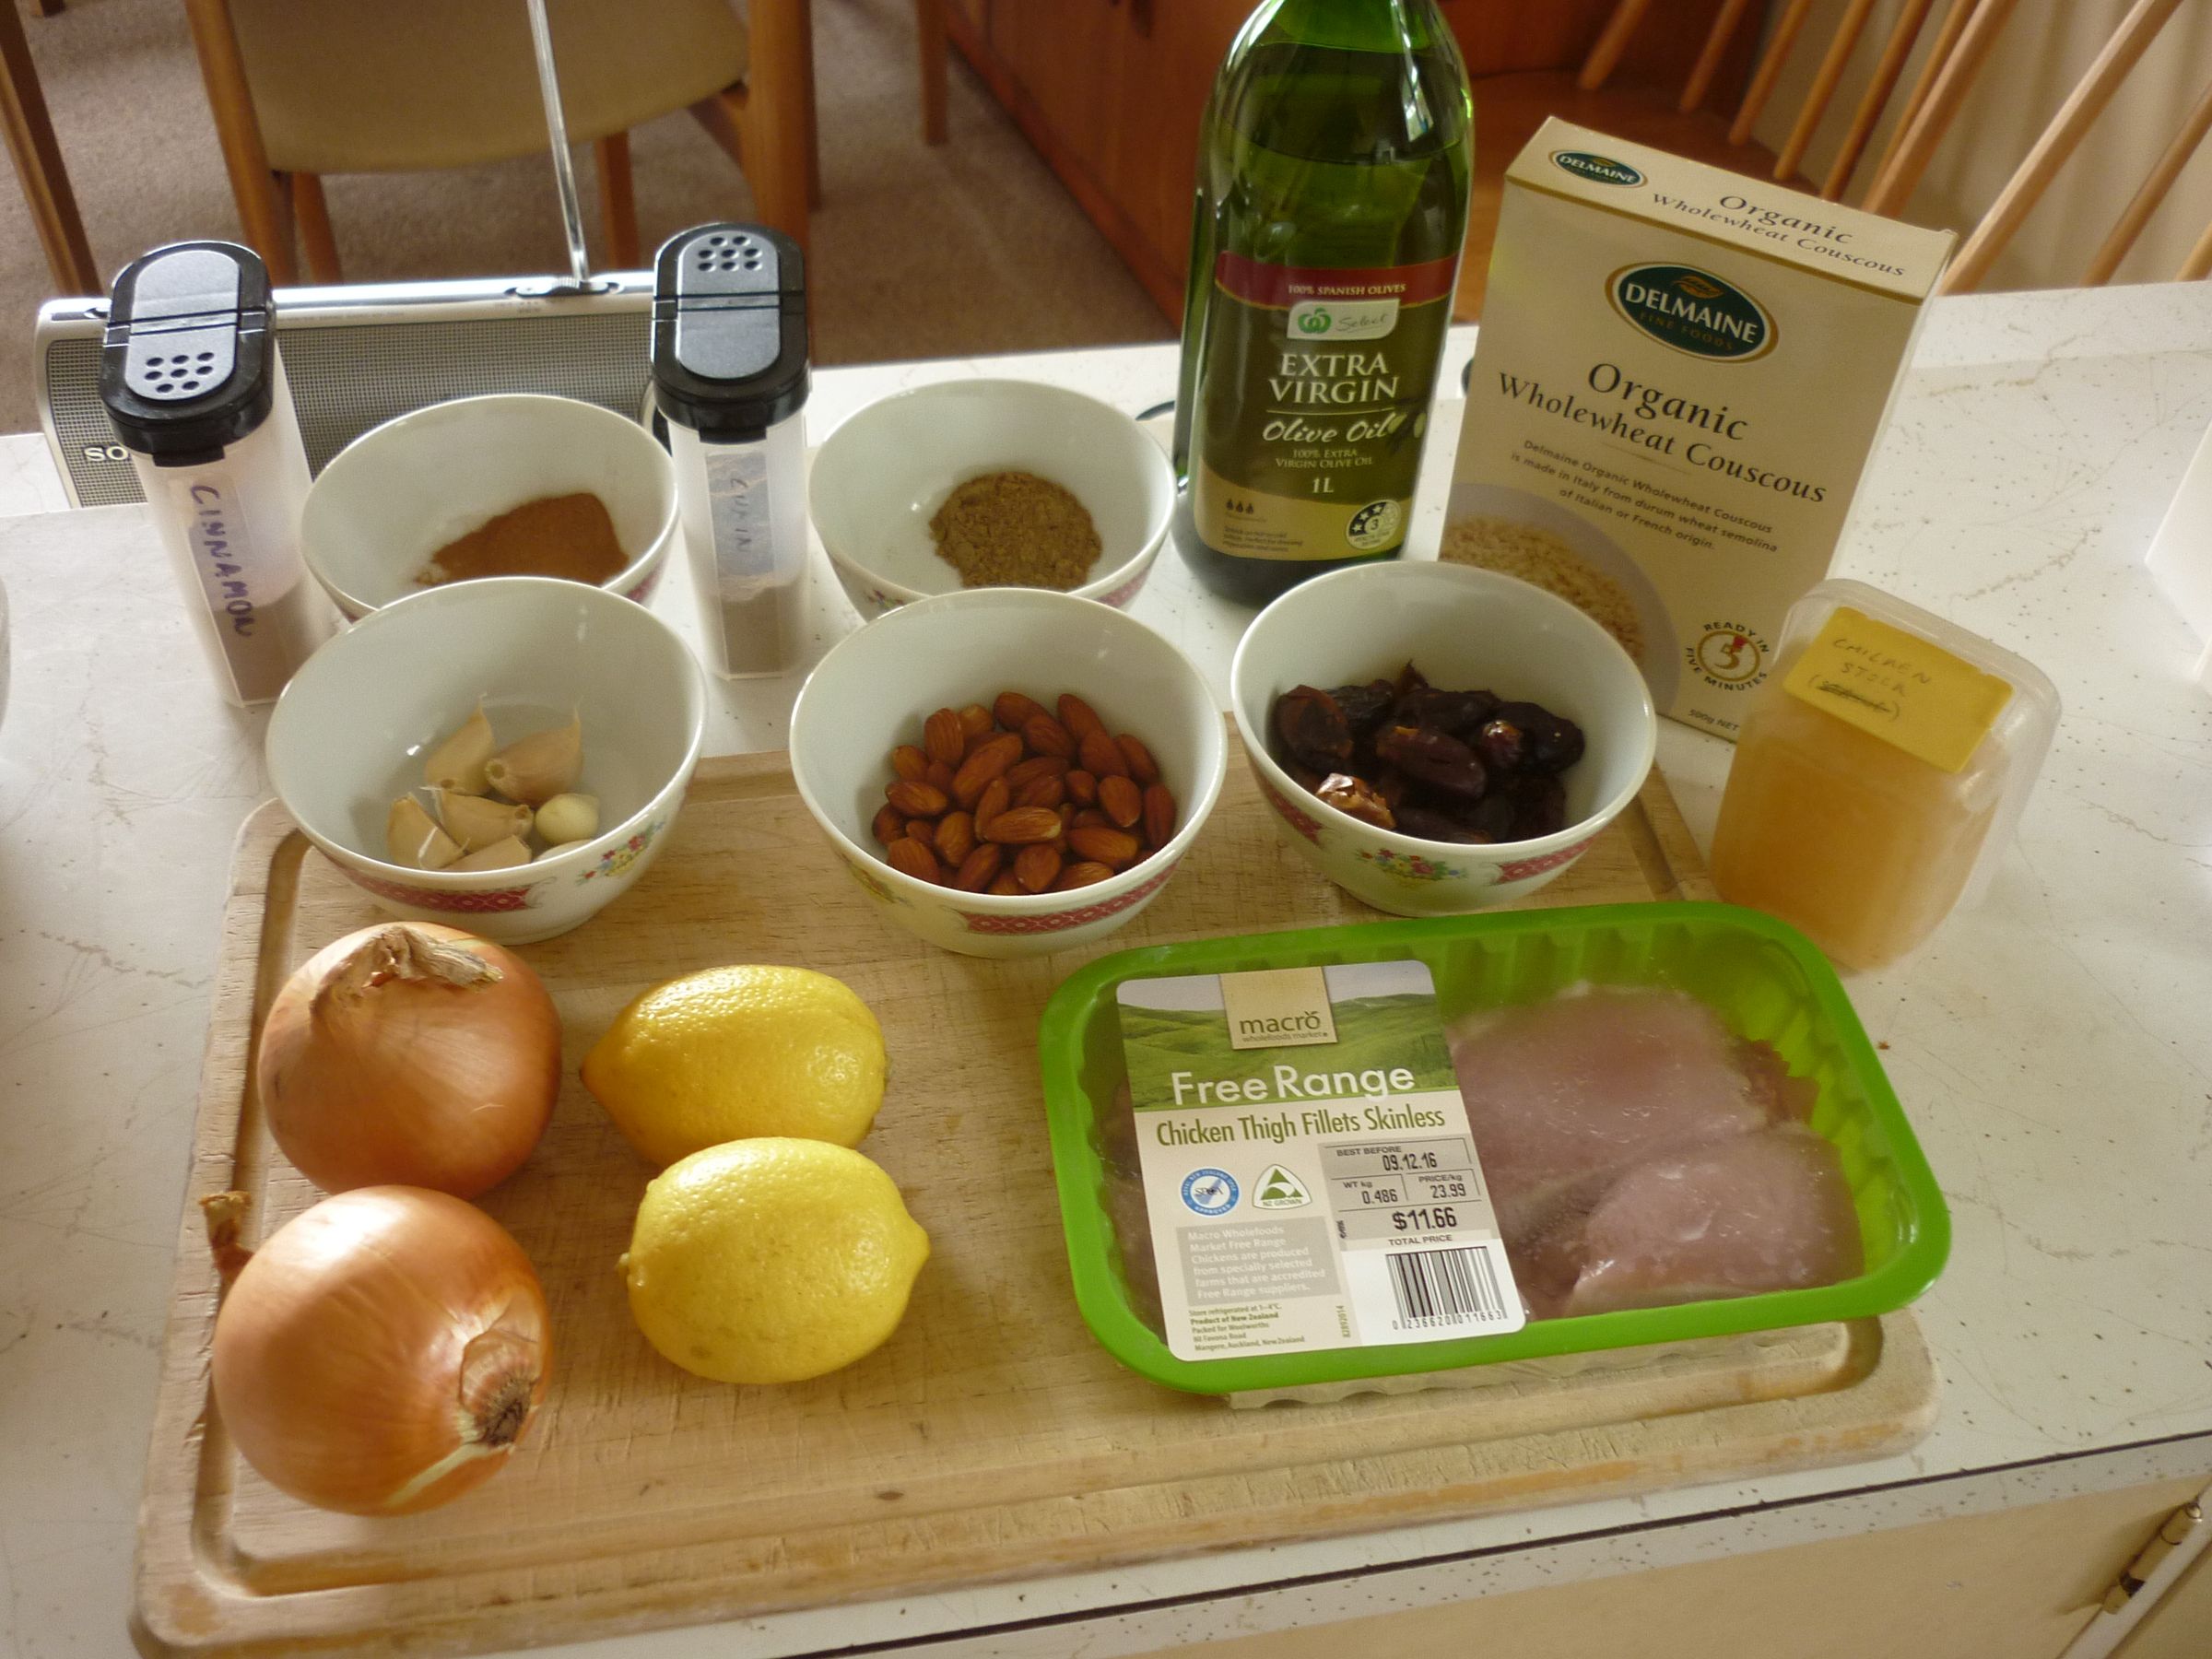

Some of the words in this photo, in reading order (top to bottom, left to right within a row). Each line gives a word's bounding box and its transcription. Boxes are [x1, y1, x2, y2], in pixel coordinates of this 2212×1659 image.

[1559, 156, 1637, 182] DELMAINE
[1720, 194, 1854, 245] Organic
[1653, 193, 1788, 243] Wholewheat
[1796, 237, 1906, 277] Couscous
[1288, 285, 1314, 294] 100%
[1318, 286, 1365, 296] SPANISH
[1368, 283, 1407, 295] OLIVES
[1625, 283, 1759, 344] DELMAINE
[1279, 352, 1389, 377] EXTRA
[1268, 376, 1401, 404] VIRGIN
[1588, 362, 1749, 441] Organic
[1262, 417, 1339, 443] Olive
[1346, 412, 1396, 442] Oil
[1499, 371, 1676, 455] Wholewheat
[1686, 442, 1828, 503] Couscous
[84, 445, 129, 461] SO
[1275, 458, 1317, 469] VIRGIN
[1319, 459, 1352, 469] OLIVE
[1354, 456, 1373, 466] OIL
[1292, 449, 1321, 459] 100%
[1324, 449, 1358, 459] EXTRA
[1312, 476, 1335, 495] 1L
[1524, 440, 1579, 466] Delmaine
[1582, 462, 1630, 486] Organic
[1632, 479, 1711, 514] Wholewheat
[1713, 508, 1773, 534] Couscous
[1512, 453, 1521, 462] is
[1524, 458, 1556, 476] made
[1559, 470, 1571, 480] in
[1573, 476, 1600, 493] Italy
[1603, 487, 1632, 503] from
[1635, 500, 1675, 519] durum
[1678, 514, 1718, 534] wheat
[1721, 528, 1778, 552] semolina
[1559, 489, 1574, 499] of
[1575, 494, 1613, 513] Italian
[1616, 511, 1630, 519] or
[1631, 514, 1673, 535] French
[1371, 518, 1380, 531] 3
[190, 484, 256, 638] CINNAMON
[1703, 621, 1756, 638] READY
[1757, 640, 1770, 653] IN
[1686, 647, 1702, 674] FIVE
[1703, 671, 1768, 691] MINUTES
[1716, 719, 1741, 732] NET
[1171, 1071, 1268, 1105] Free
[1274, 1065, 1416, 1100] Range
[1157, 1122, 1234, 1147] Chicken
[1237, 1112, 1297, 1144] Thigh
[1300, 1108, 1361, 1135] Fillets
[1364, 1103, 1446, 1131] Skinless
[1336, 1148, 1360, 1157] BEST
[1363, 1146, 1402, 1155] BEFORE
[1382, 1152, 1438, 1171] 09.12.16
[1343, 1181, 1358, 1189] WT
[1360, 1181, 1373, 1190] kg
[1418, 1174, 1464, 1183] PRICE/kg
[1362, 1189, 1398, 1205] 0.486
[1430, 1183, 1466, 1199] 23.99
[1392, 1207, 1457, 1231] $11.66
[1188, 1231, 1219, 1241] Macro
[1222, 1226, 1285, 1239] Wholefoods
[1388, 1237, 1421, 1246] TOTAL
[1423, 1234, 1453, 1243] PRICE
[1190, 1242, 1227, 1253] Market
[1229, 1240, 1252, 1250] Free
[1253, 1238, 1287, 1248] Range
[1191, 1253, 1239, 1265] Chickens
[1241, 1253, 1258, 1261] are
[1260, 1246, 1310, 1261] produced
[1193, 1266, 1218, 1277] from
[1220, 1262, 1266, 1275] specially
[1268, 1258, 1313, 1270] selected
[1195, 1277, 1227, 1288] farms
[1227, 1275, 1250, 1285] that
[1252, 1274, 1269, 1283] are
[1271, 1268, 1326, 1282] accredited
[1197, 1288, 1221, 1300] Free
[1222, 1287, 1256, 1298] Range
[1190, 1317, 1220, 1325] Product
[1248, 1312, 1279, 1321] Zealand
